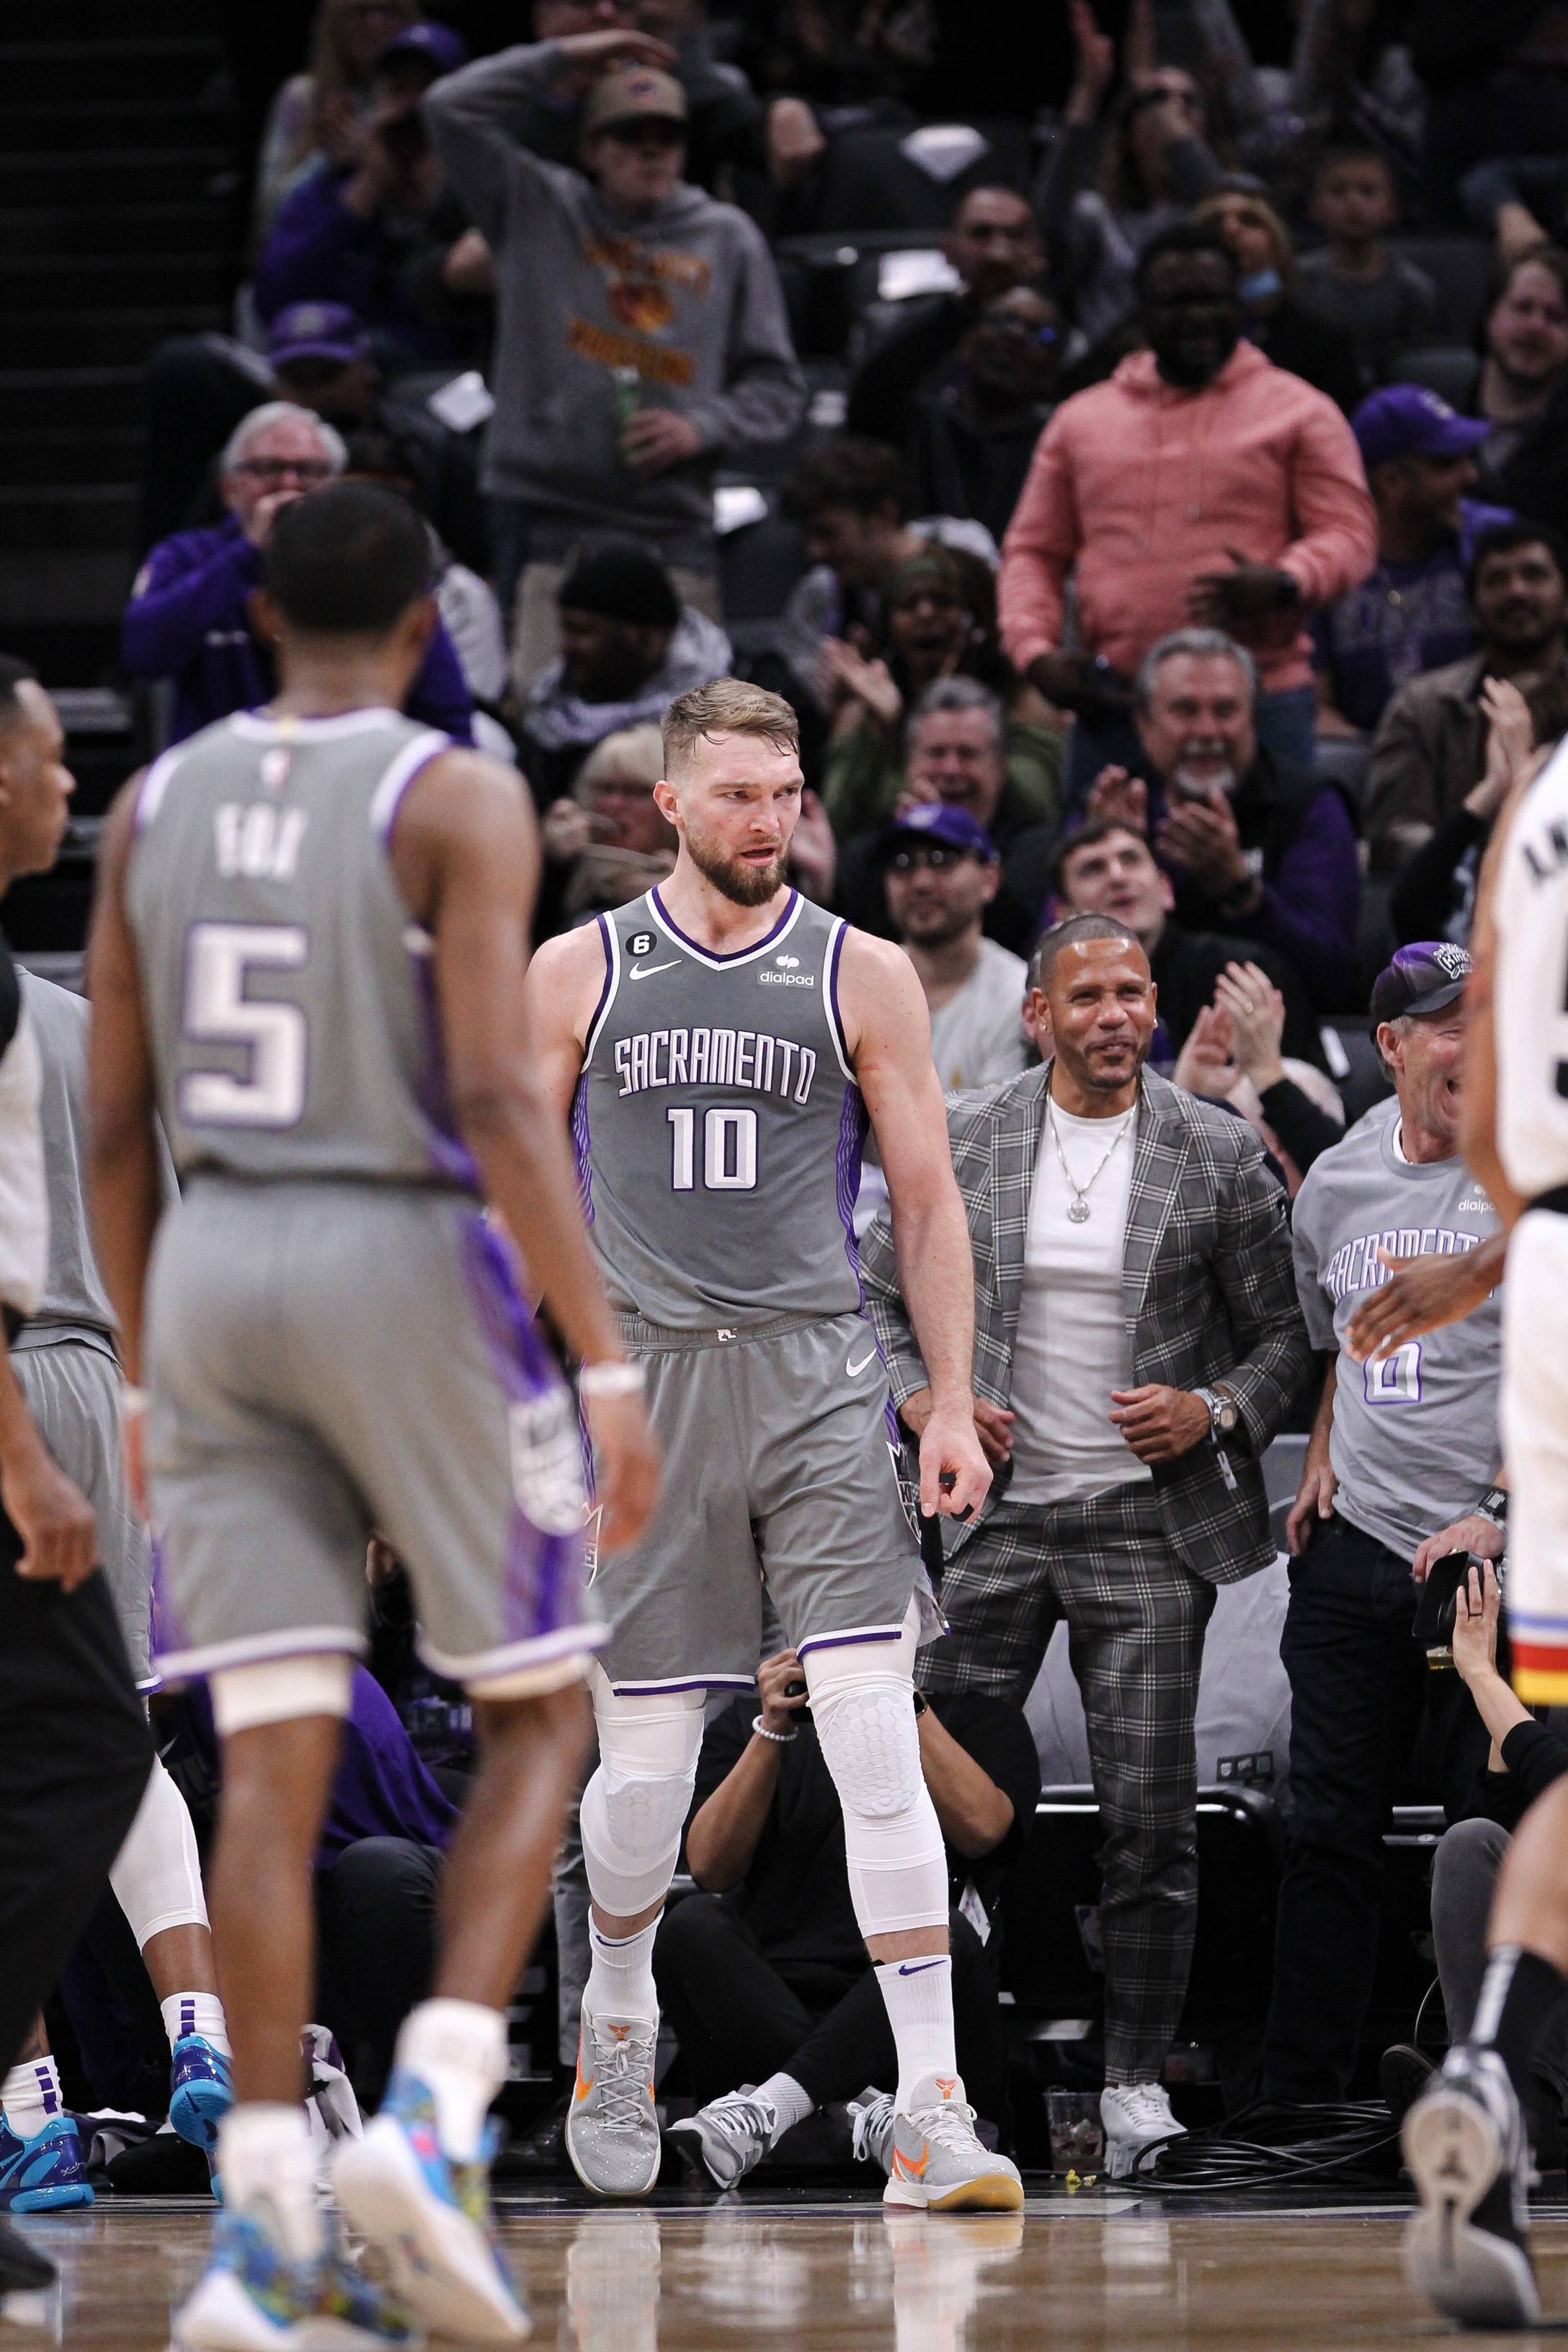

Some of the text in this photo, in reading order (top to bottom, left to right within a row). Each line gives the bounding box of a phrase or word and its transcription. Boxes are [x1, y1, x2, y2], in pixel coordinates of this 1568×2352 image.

[633, 935, 650, 954] 6
[760, 971, 814, 986] dialpad
[177, 922, 308, 1131] 5
[614, 1028, 816, 1106] SACRAMENTO
[666, 1107, 759, 1190] 10
[1458, 1199, 1496, 1214] dialpa
